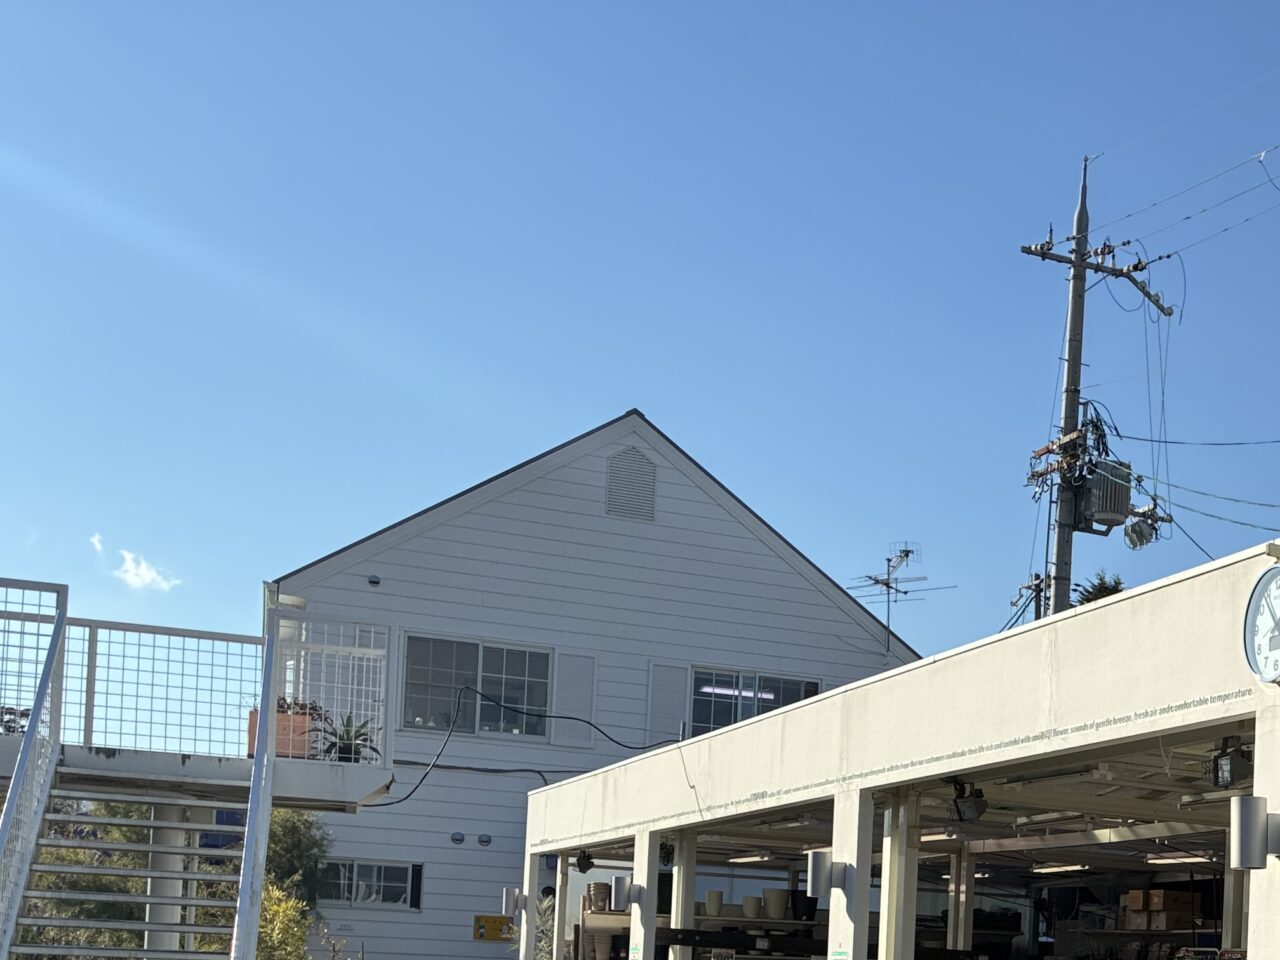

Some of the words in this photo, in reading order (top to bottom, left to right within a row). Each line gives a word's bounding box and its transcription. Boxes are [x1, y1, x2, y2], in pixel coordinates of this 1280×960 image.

[1255, 625, 1260, 636] 9
[1257, 644, 1262, 655] 8
[1264, 656, 1269, 668] 7
[1273, 659, 1279, 671] 6
[1070, 723, 1089, 734] sounds
[1089, 720, 1095, 730] of
[1095, 717, 1112, 731] gentle
[1134, 709, 1149, 720] fresh
[1149, 707, 1158, 717] air
[1159, 704, 1170, 716] and
[1170, 696, 1209, 713] comfortable
[1209, 688, 1255, 704] temperature.
